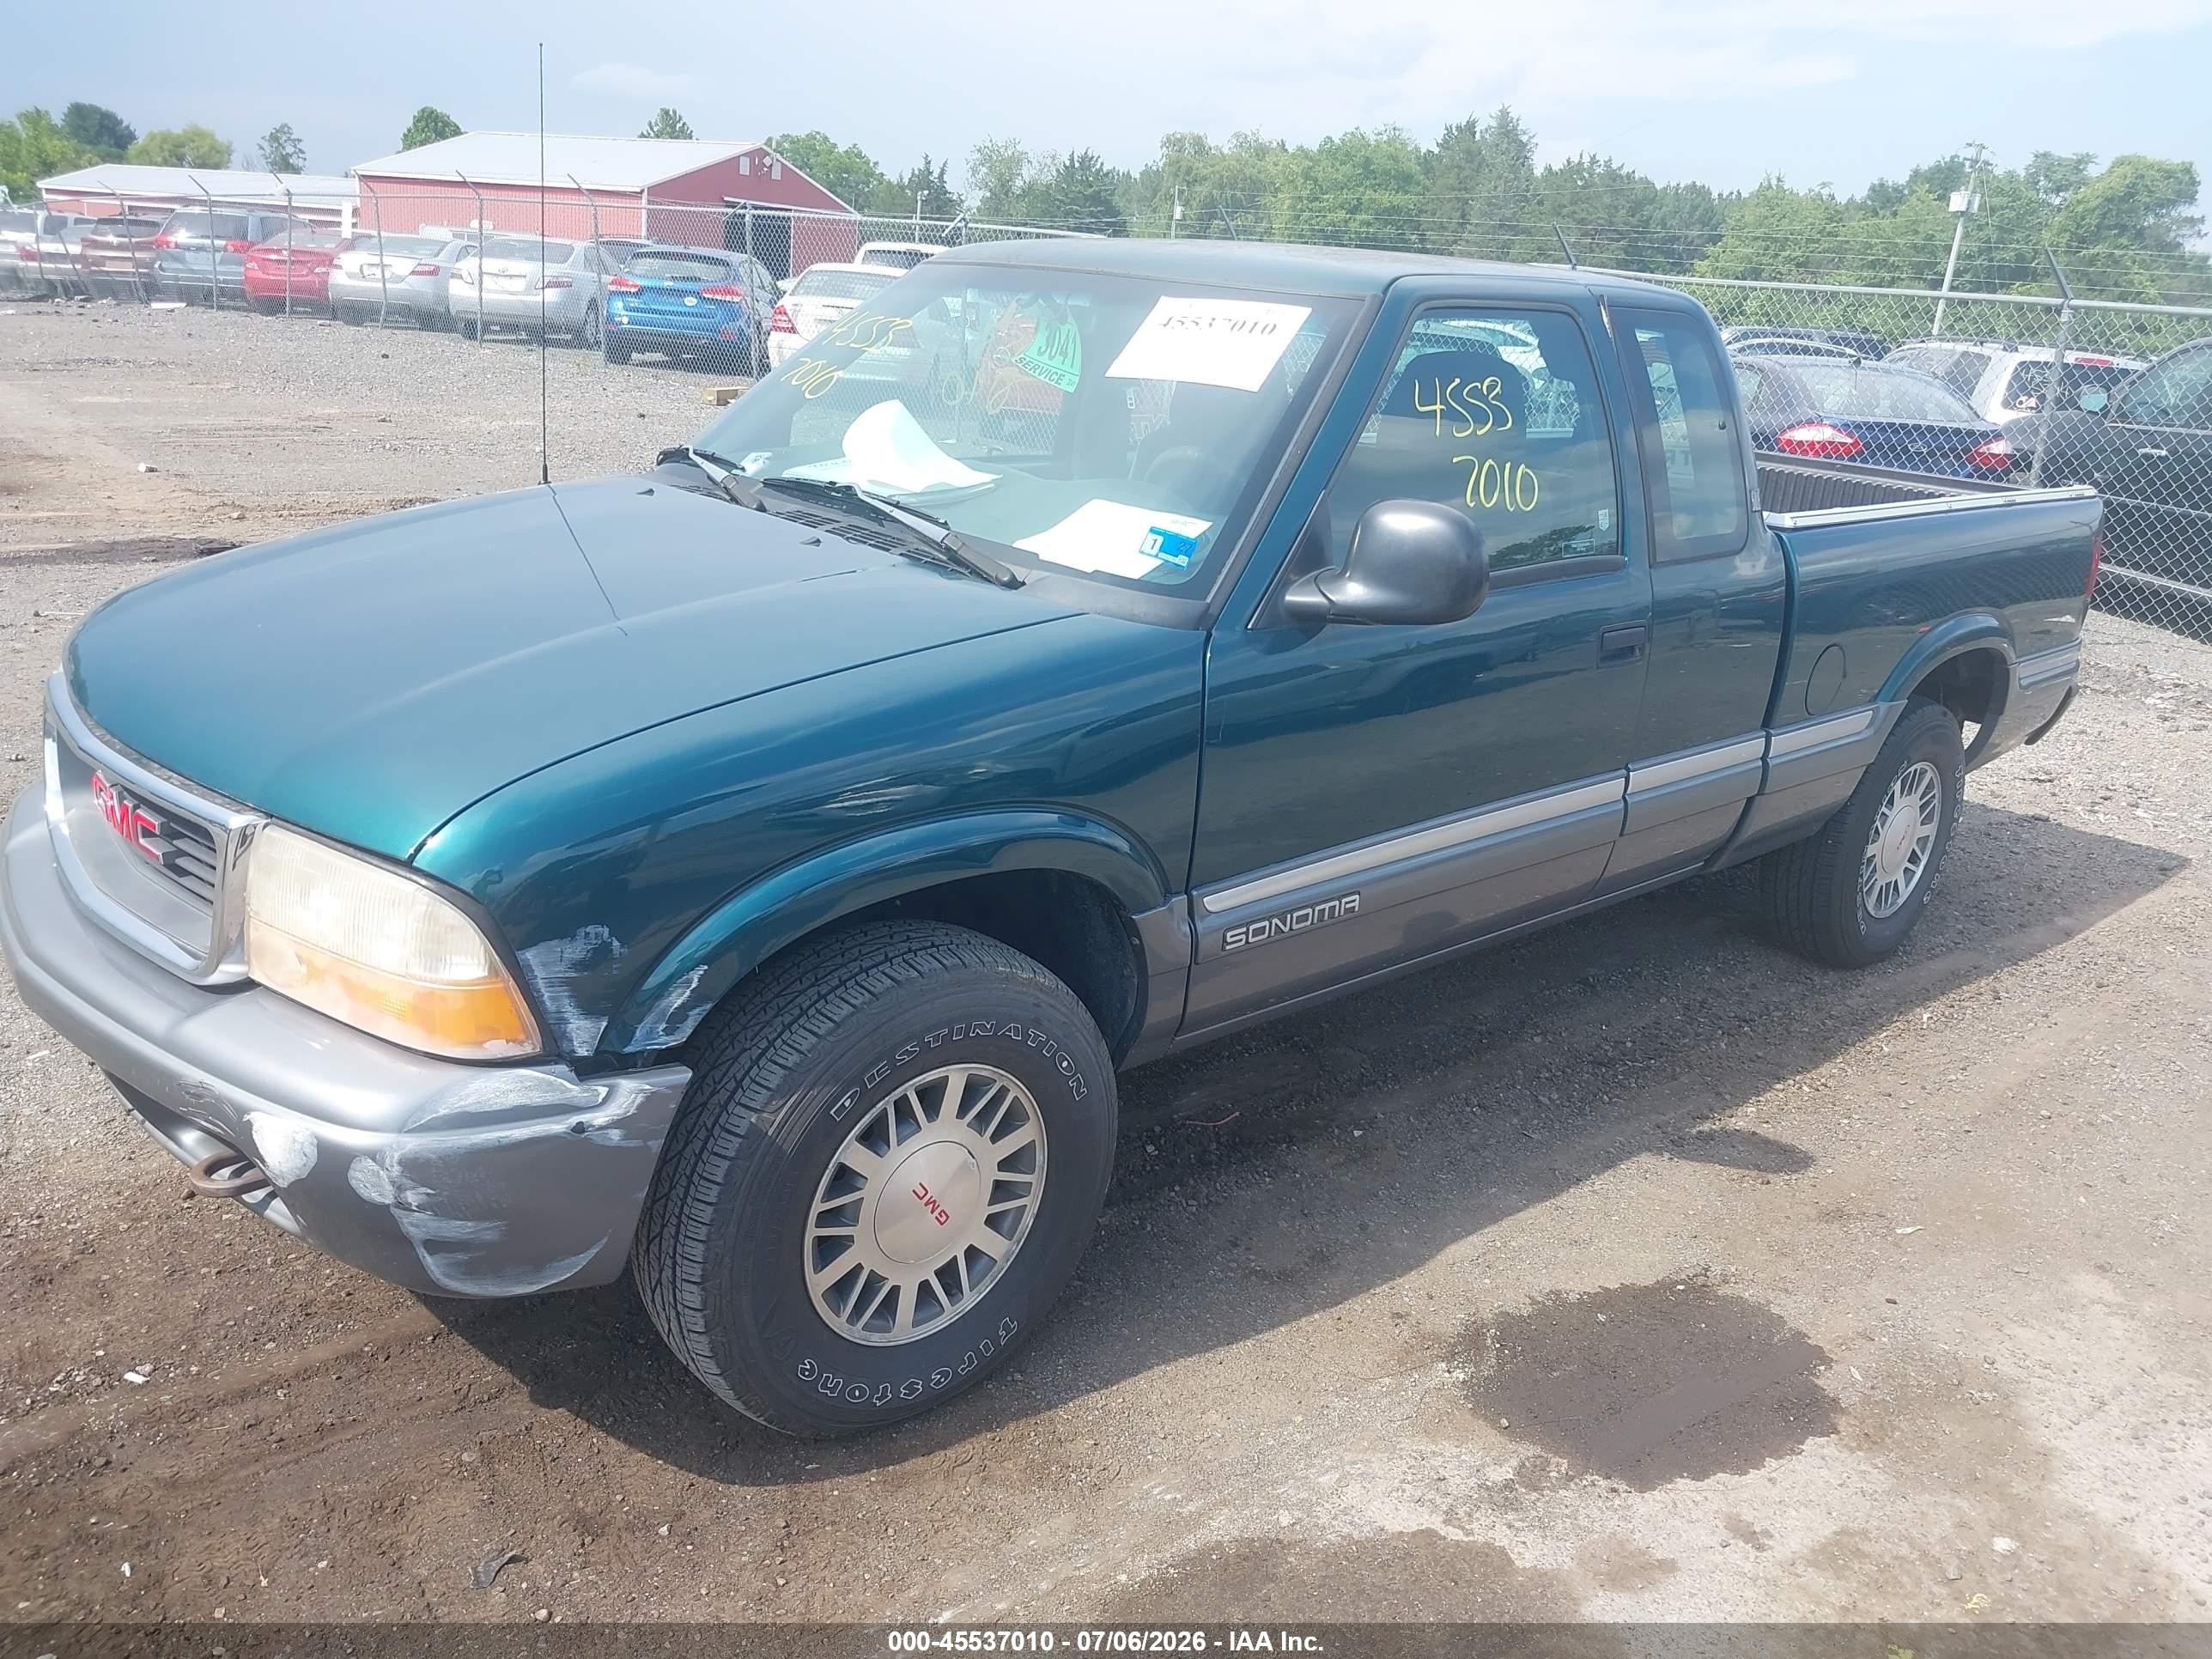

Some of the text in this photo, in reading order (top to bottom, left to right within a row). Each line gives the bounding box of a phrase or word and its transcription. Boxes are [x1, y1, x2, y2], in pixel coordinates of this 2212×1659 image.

[1014, 356, 1066, 386] SERVICE
[1414, 375, 1513, 438] 4553
[1452, 454, 1539, 512] 7010
[1151, 538, 1158, 550] 1
[91, 770, 166, 865] GMC
[1223, 892, 1360, 951] SONOMA
[829, 1020, 1088, 1122] DESTINATION
[912, 1182, 950, 1226] GMC
[797, 1316, 1018, 1407] Firestone
